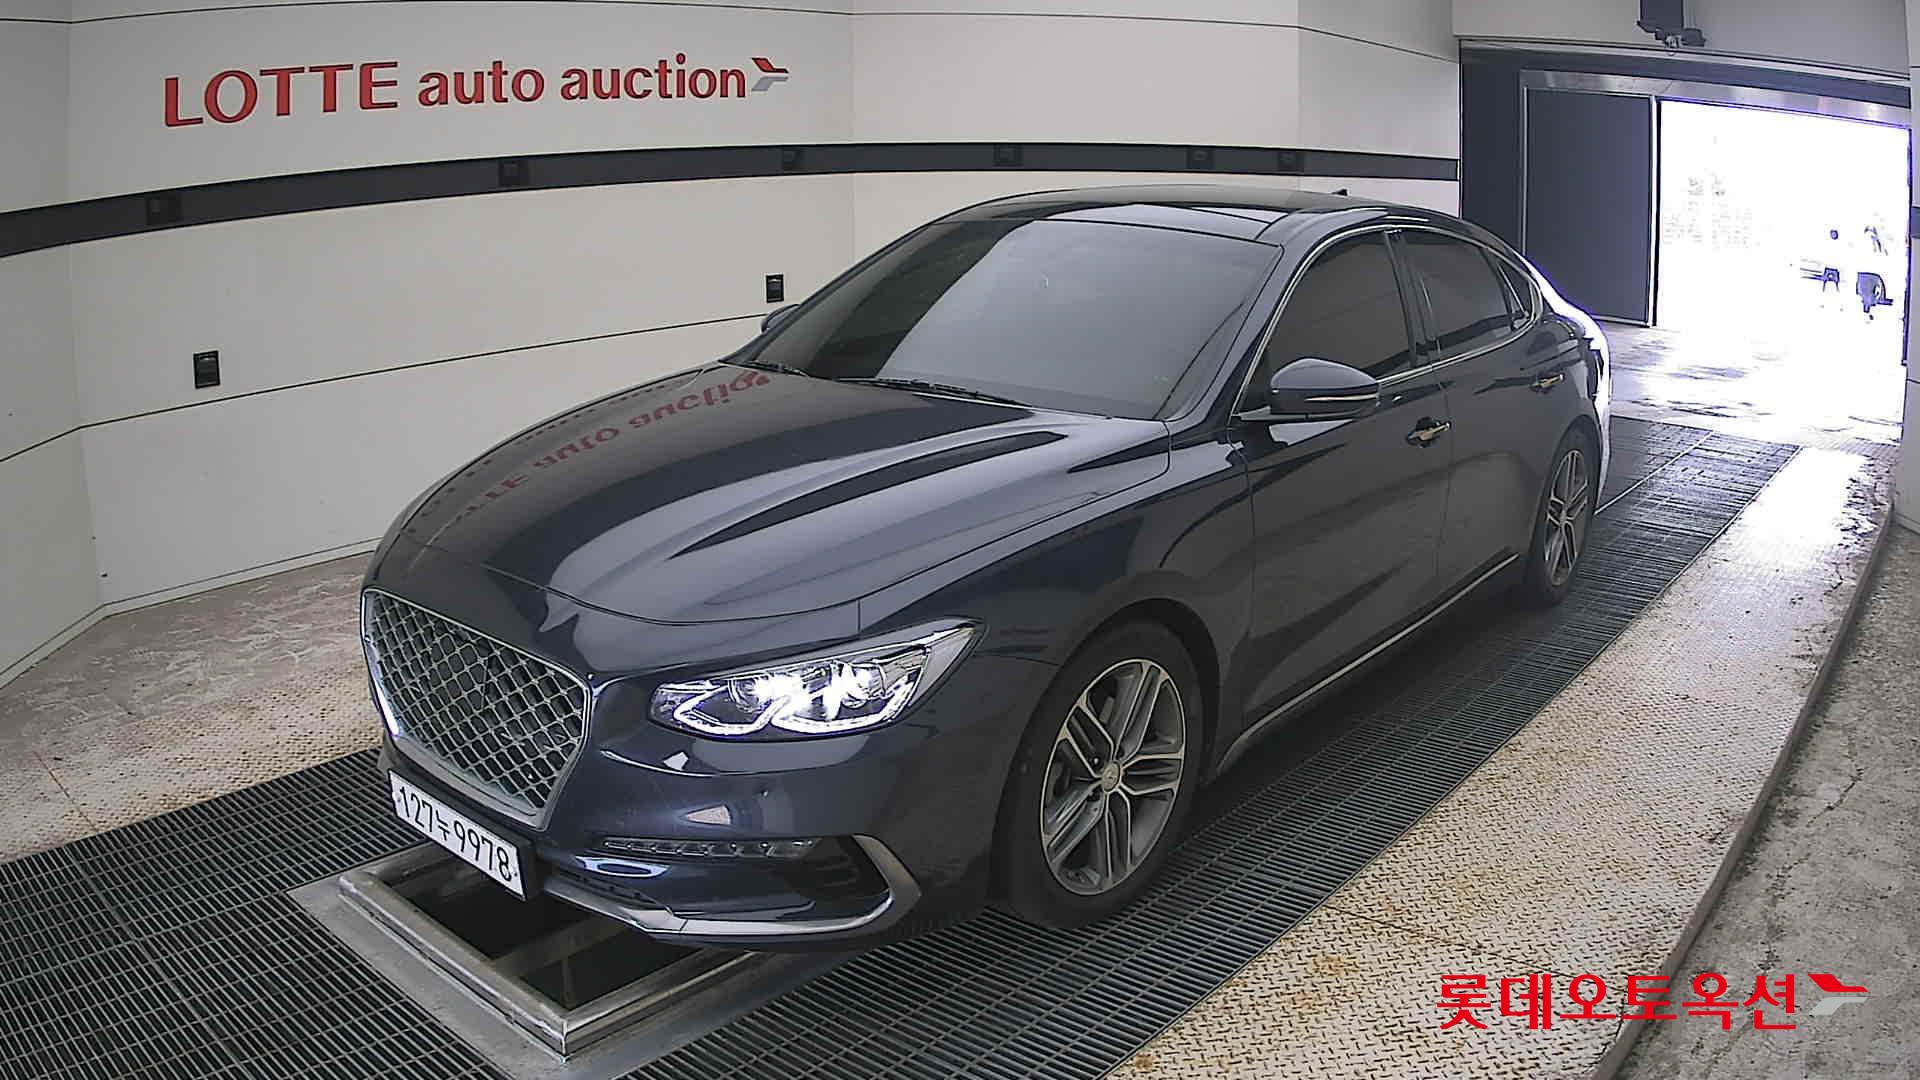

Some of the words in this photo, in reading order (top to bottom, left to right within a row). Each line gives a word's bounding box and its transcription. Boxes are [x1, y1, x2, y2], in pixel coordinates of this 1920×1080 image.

[164, 61, 398, 127] LOTTE
[417, 60, 545, 106] auto
[560, 53, 747, 101] auction
